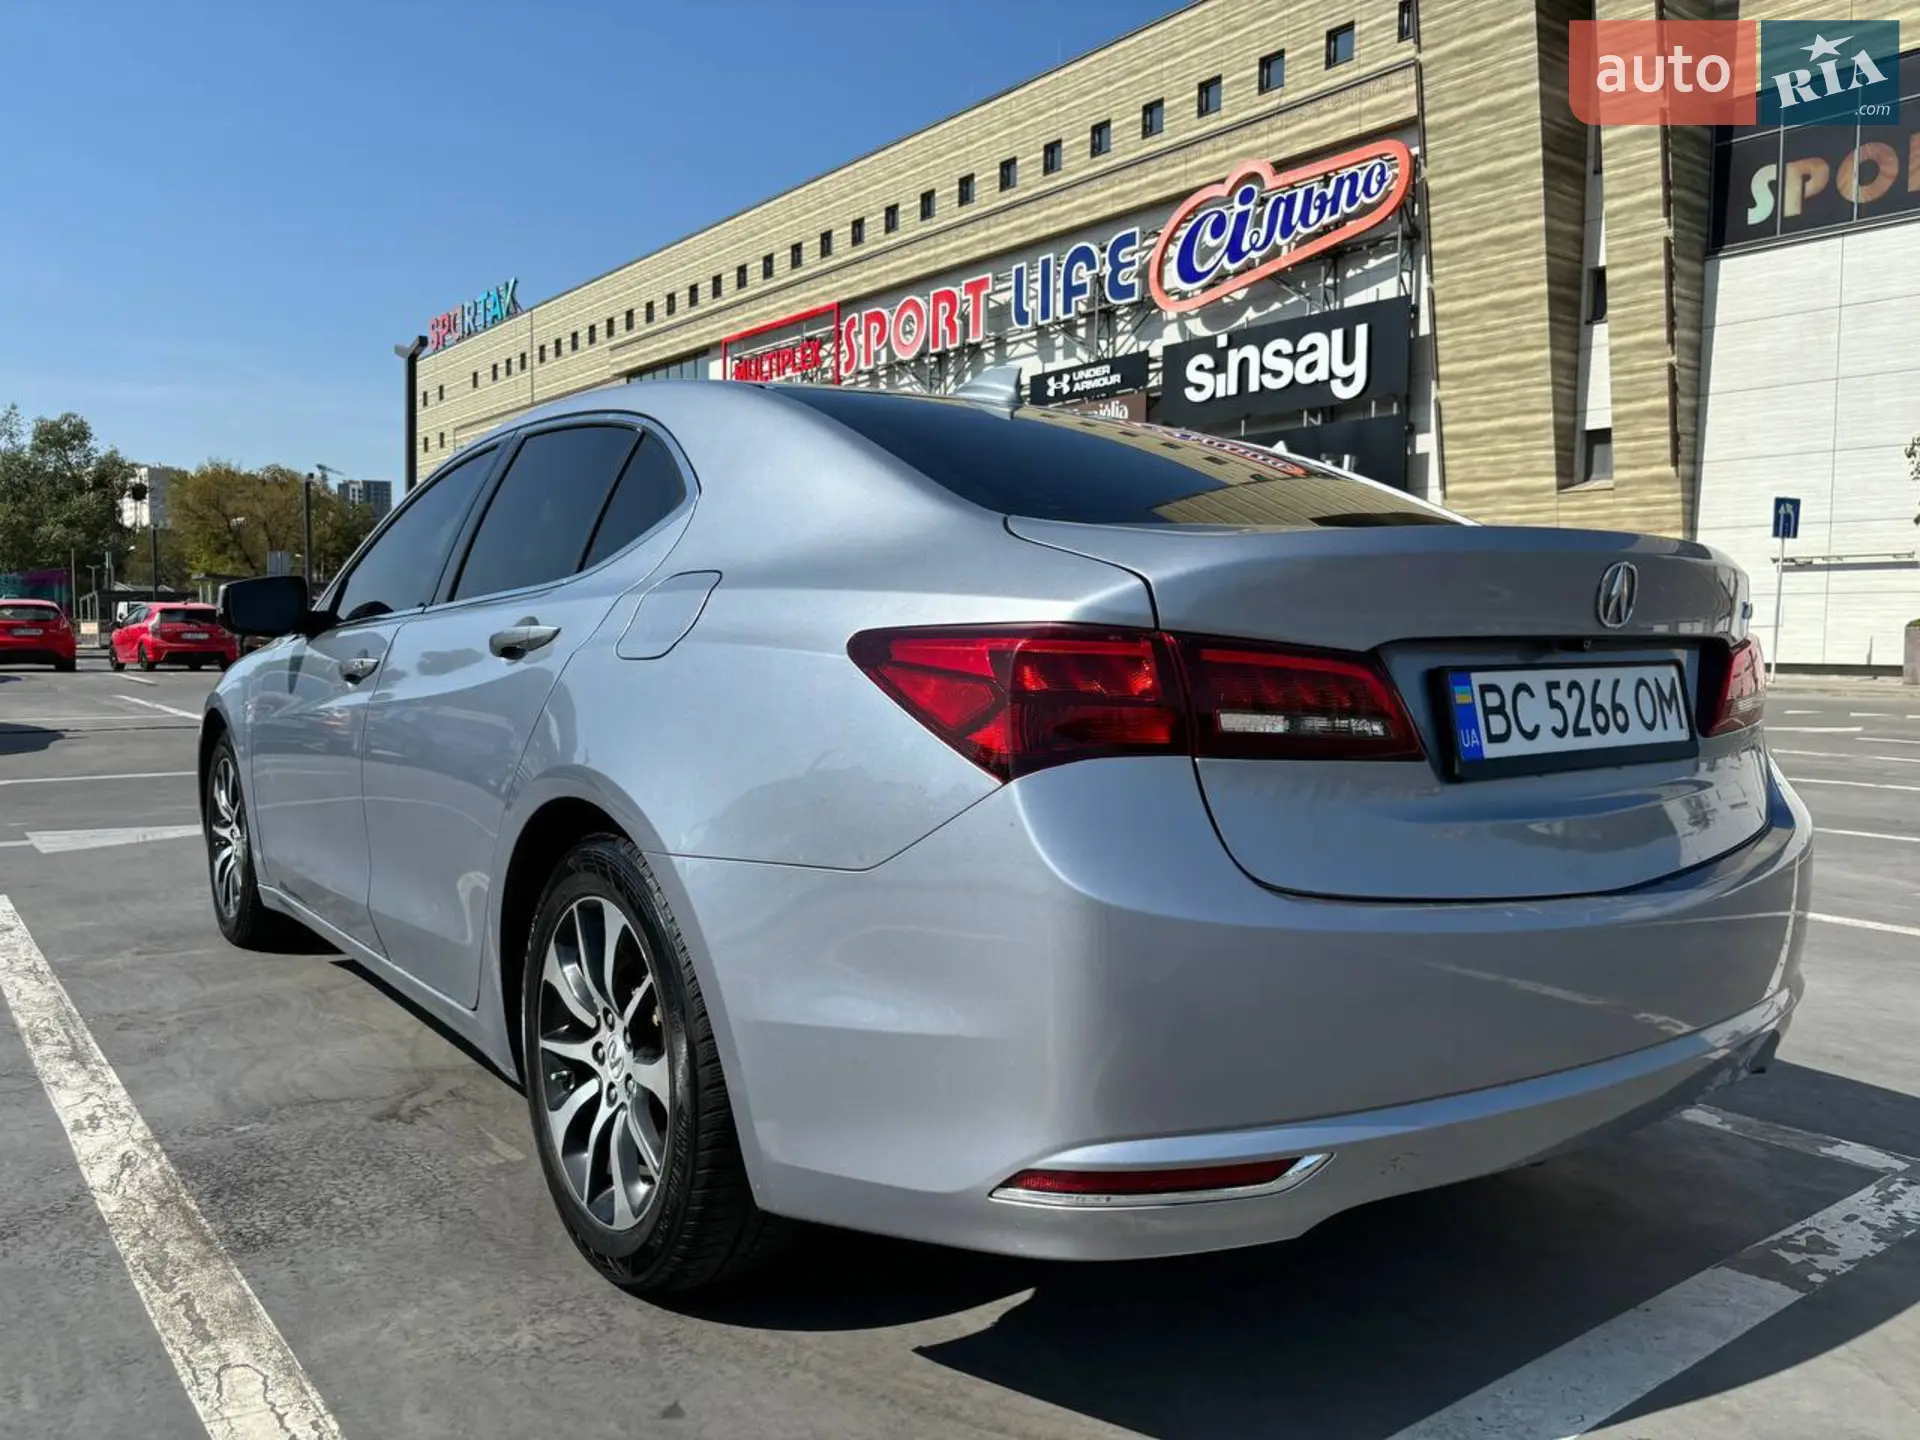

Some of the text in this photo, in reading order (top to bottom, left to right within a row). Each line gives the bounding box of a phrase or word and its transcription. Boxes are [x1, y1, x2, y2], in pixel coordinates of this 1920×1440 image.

[1747, 132, 1920, 225] SPO
[1176, 158, 1392, 290] Сільпо
[841, 226, 1142, 377] SPORT LIFE
[734, 339, 822, 382] MULTIPLEX
[1072, 364, 1111, 381] UNDER
[1072, 374, 1121, 392] ARMOUR
[1184, 323, 1371, 403] sinsay
[1461, 728, 1481, 748] UA
[1478, 677, 1685, 744] BC 5266 OM
